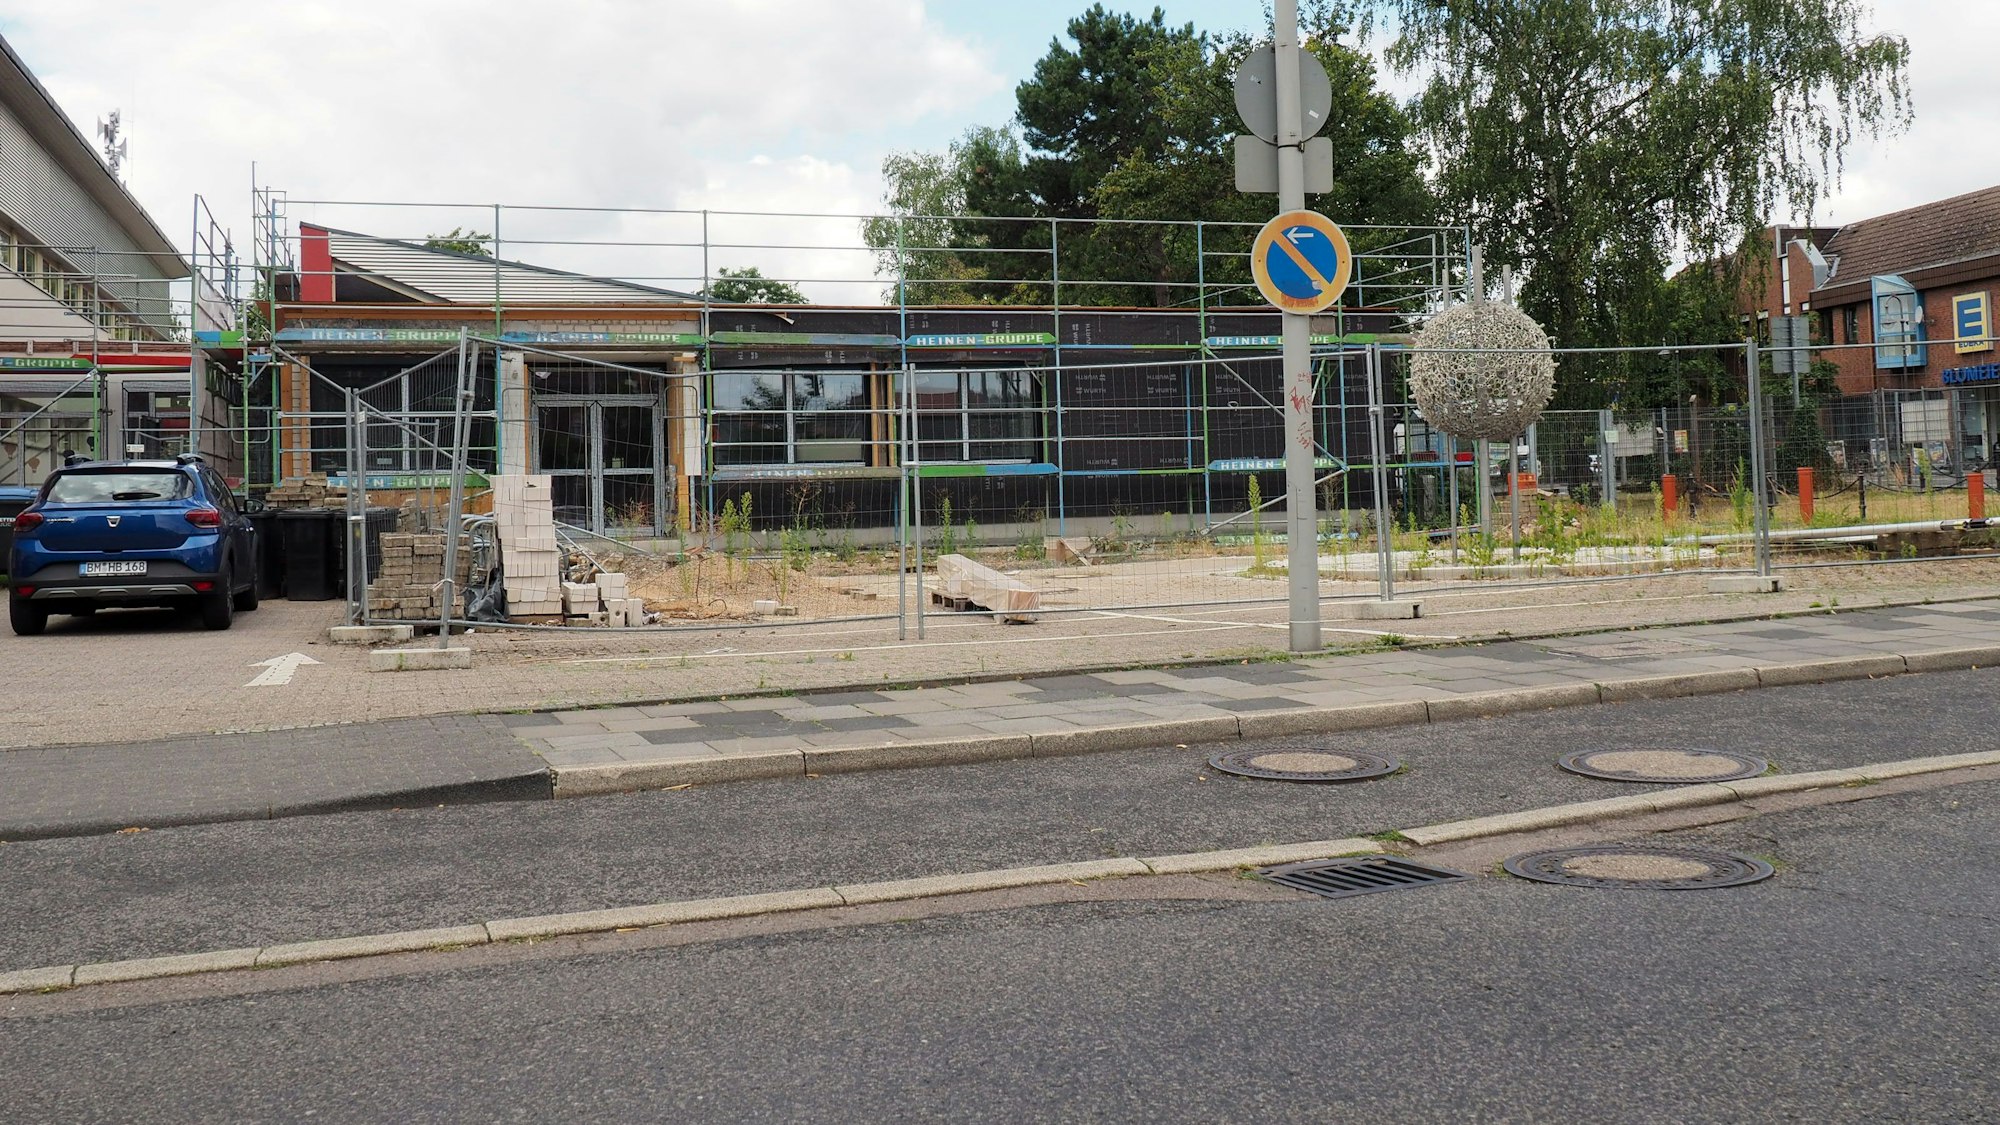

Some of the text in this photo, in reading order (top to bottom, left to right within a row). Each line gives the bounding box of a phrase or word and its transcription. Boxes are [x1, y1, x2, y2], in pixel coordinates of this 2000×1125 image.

[916, 334, 1044, 346] HEINEN-GRUPPE
[87, 561, 145, 572] BM HB 168
